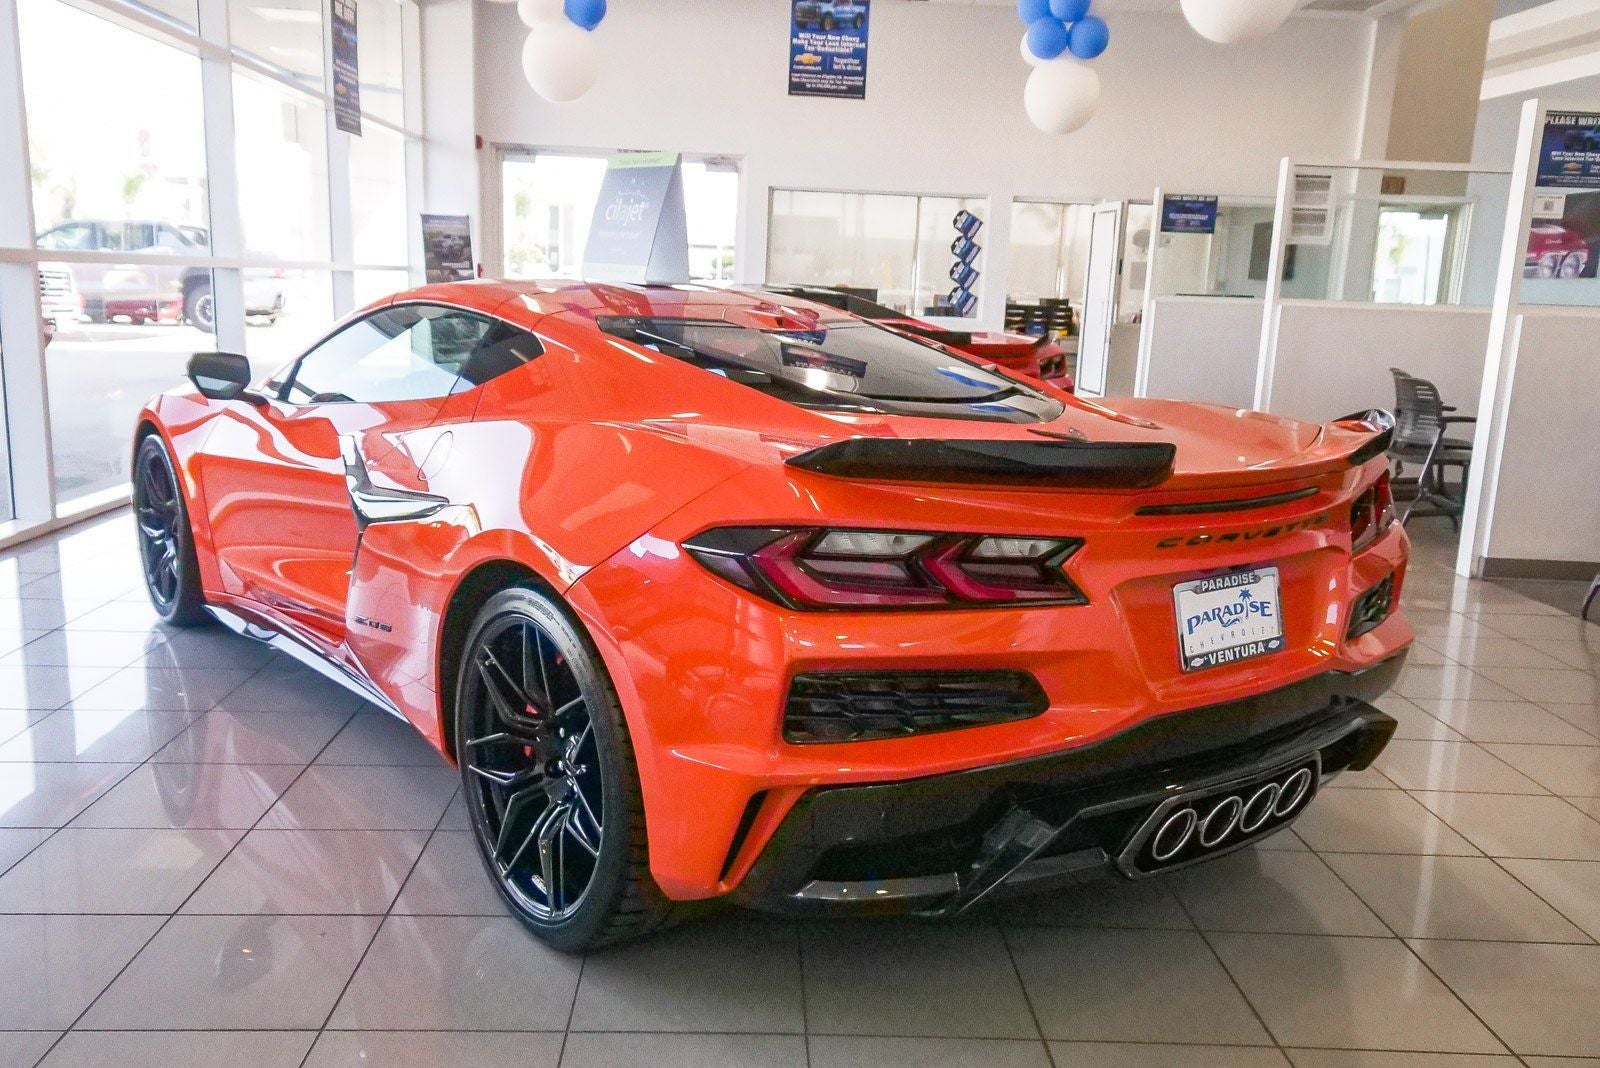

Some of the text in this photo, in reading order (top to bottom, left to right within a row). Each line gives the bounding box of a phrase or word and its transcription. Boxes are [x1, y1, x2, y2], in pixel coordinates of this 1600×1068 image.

[1156, 515, 1329, 548] CORVETTE
[1201, 572, 1255, 592] PARADISE
[1186, 596, 1273, 635] PARADISE
[1189, 626, 1275, 654] CHEVROLET
[1207, 641, 1265, 666] VENTURA
